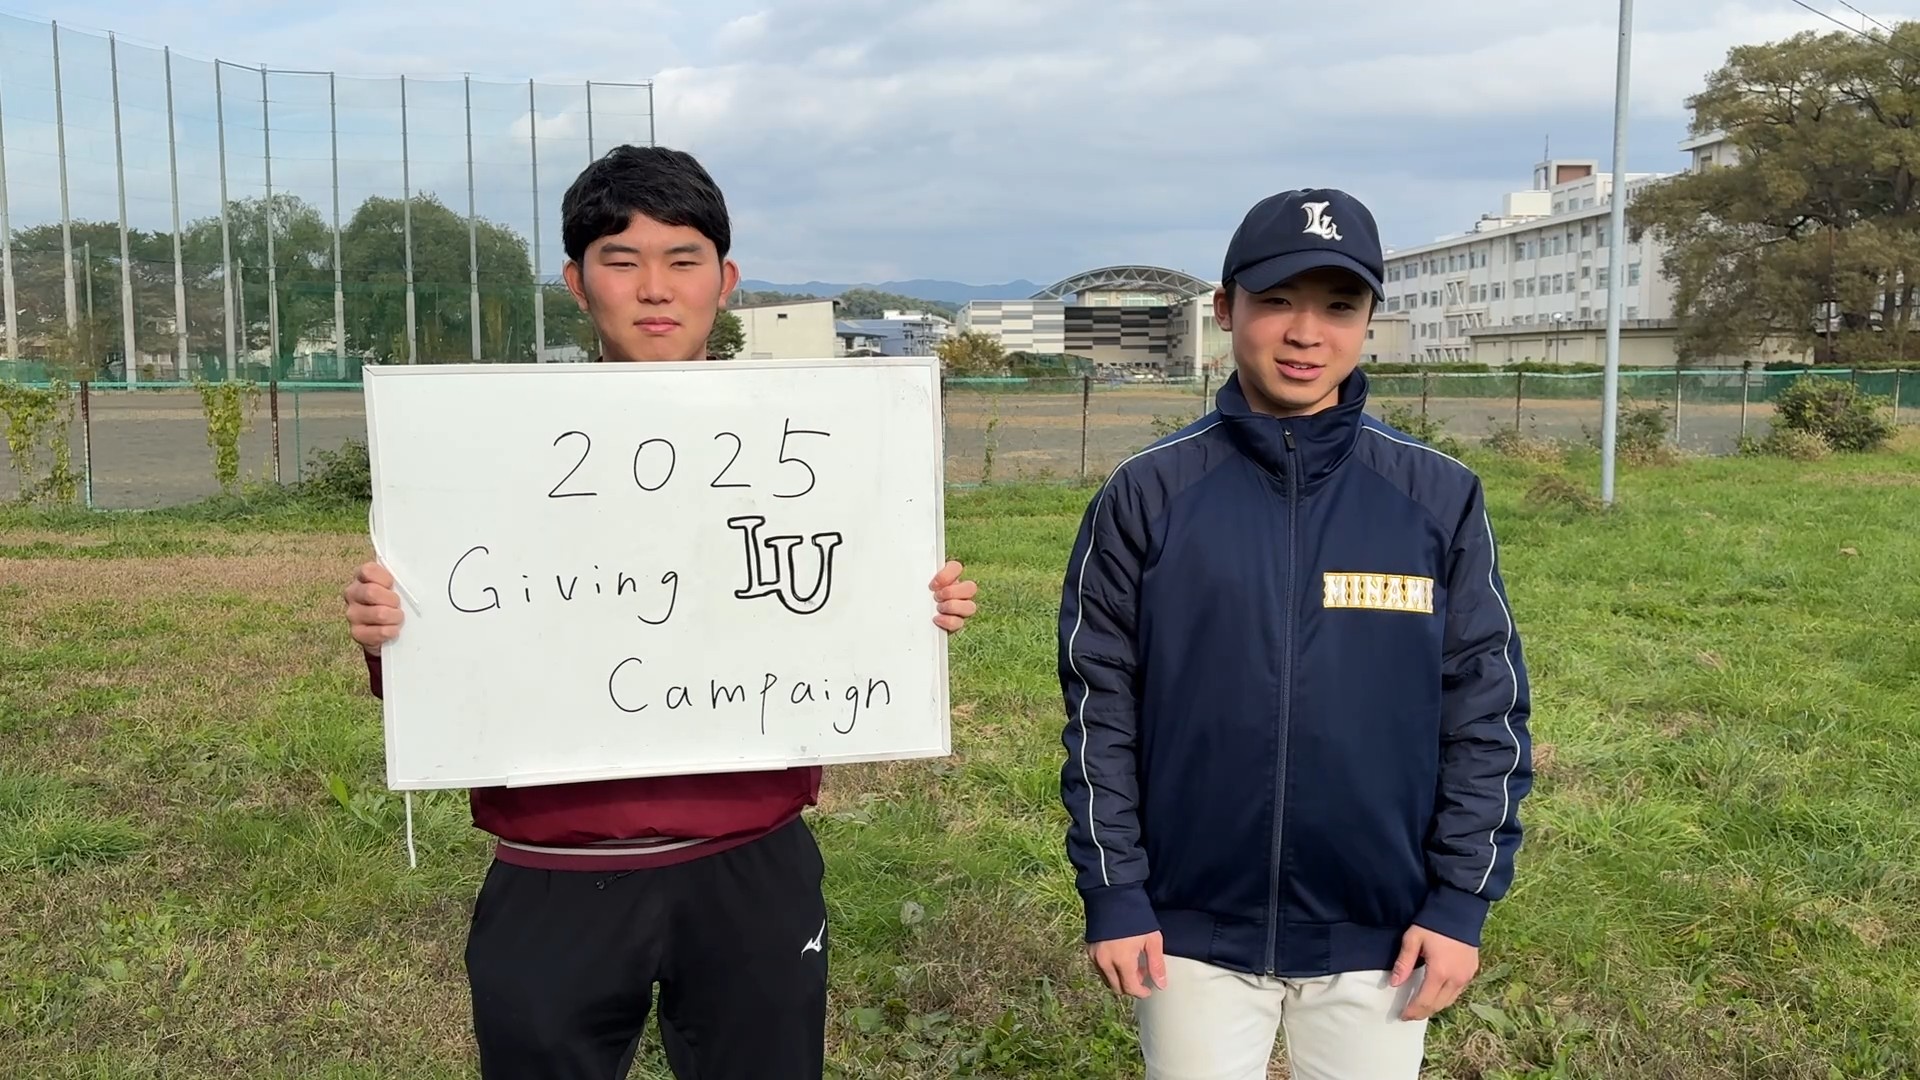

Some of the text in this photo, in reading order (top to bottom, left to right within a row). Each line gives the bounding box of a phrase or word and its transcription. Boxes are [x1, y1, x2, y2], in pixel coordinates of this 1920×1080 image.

[547, 417, 832, 499] 2025
[447, 544, 679, 625] Giving
[1323, 571, 1434, 614] MINAMI
[608, 656, 891, 735] Campaign
